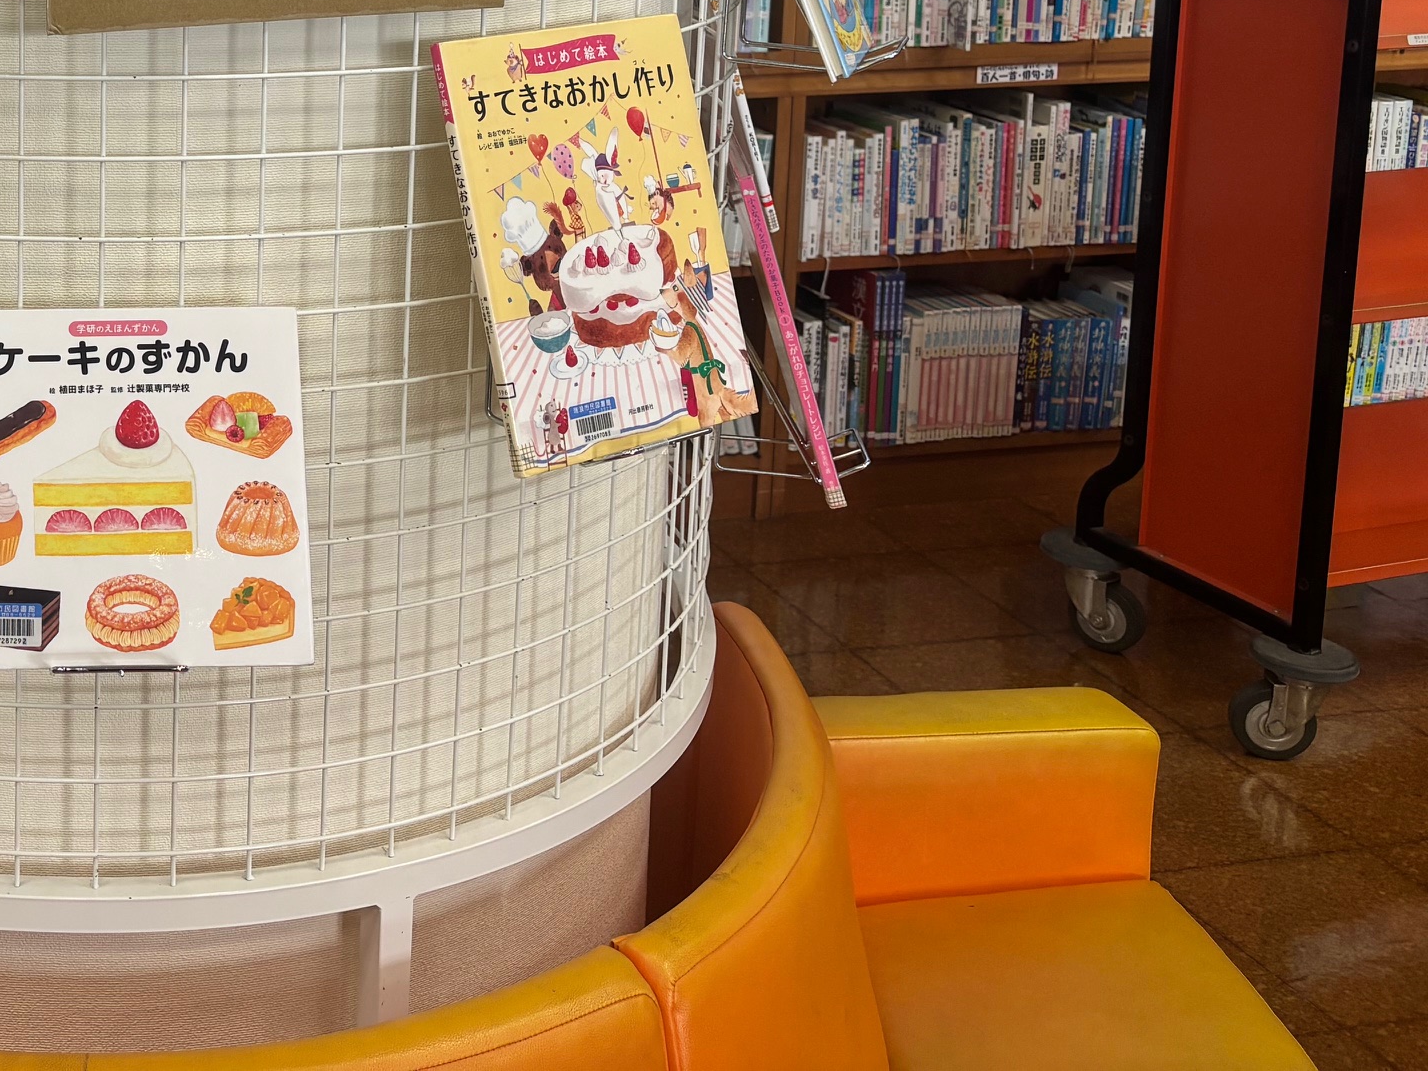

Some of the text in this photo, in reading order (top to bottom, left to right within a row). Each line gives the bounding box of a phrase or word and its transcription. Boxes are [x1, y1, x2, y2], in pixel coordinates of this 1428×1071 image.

[533, 44, 608, 67] はじめて絵本
[434, 63, 450, 117] はじめて絵本
[467, 63, 675, 123] すてきなおかし作り
[980, 68, 1055, 83] 百人一首・俳句・詩
[447, 134, 478, 259] すてきなおかし作り
[76, 323, 160, 334] 学研のえほんずかん
[59, 385, 104, 394] 植田まほ子
[110, 386, 123, 394] 監修
[127, 384, 190, 394] 辻製菓専門学校
[784, 329, 822, 441] あこがれのチョコレートレシピ
